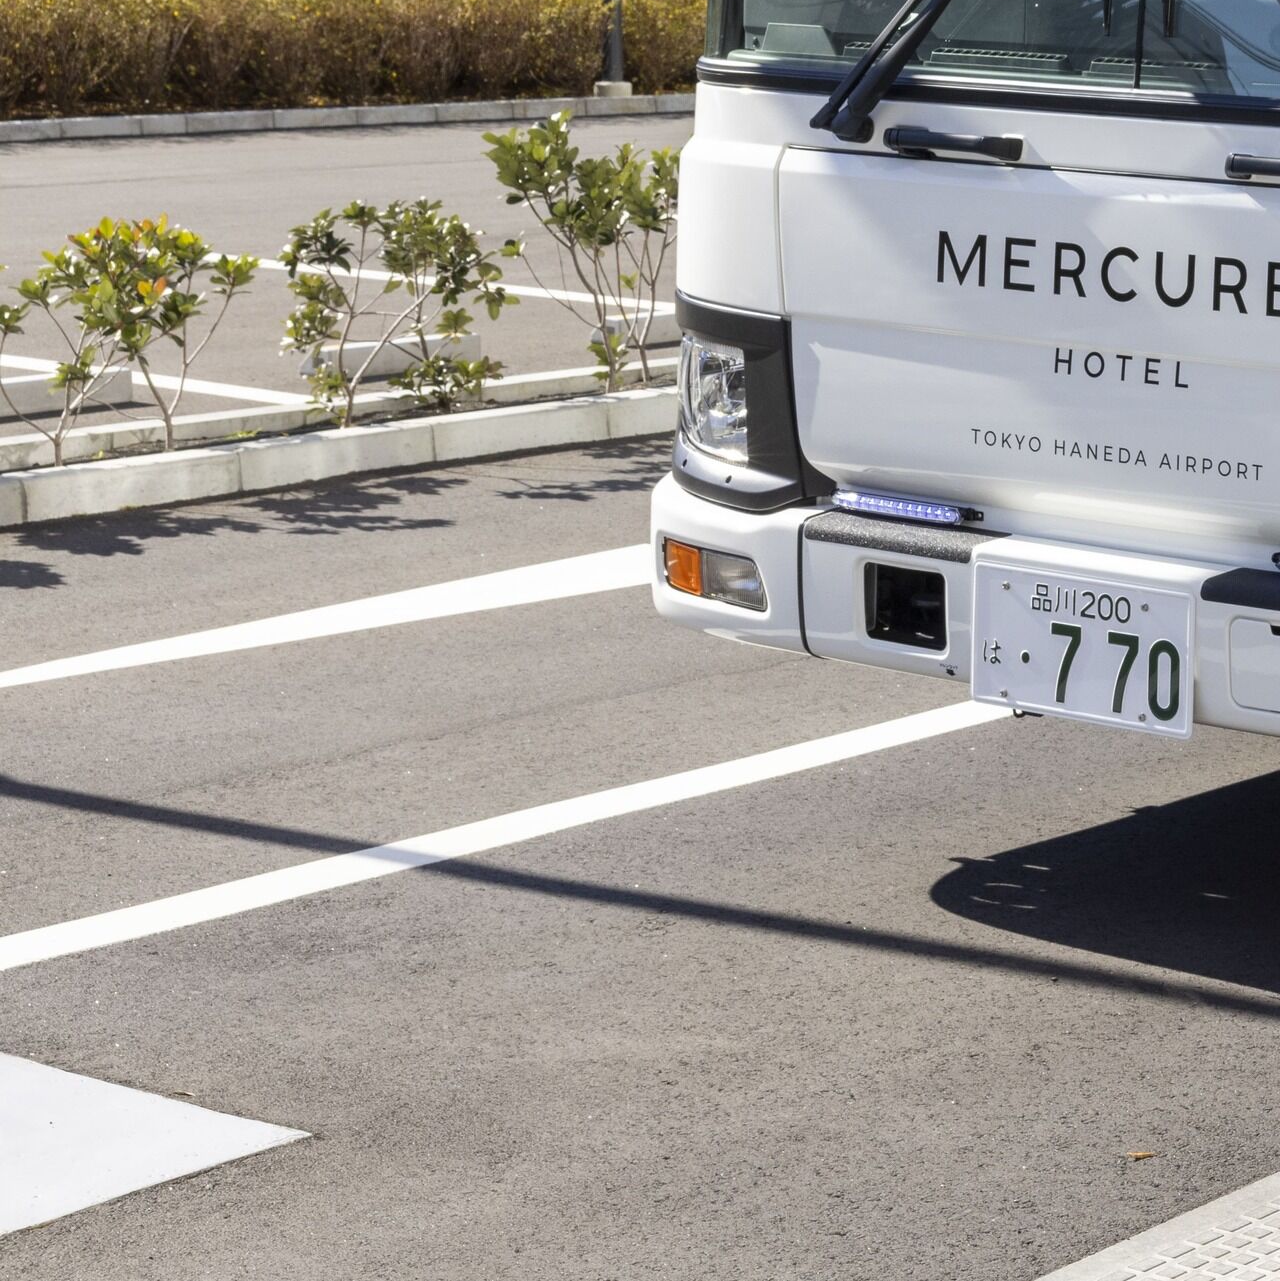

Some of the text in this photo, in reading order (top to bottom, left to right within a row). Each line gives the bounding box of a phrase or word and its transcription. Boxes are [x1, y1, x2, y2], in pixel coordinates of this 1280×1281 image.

[1053, 346, 1190, 389] HOTEL
[970, 427, 1265, 482] TOKYO HANEDA AIRPORT
[982, 638, 1002, 665] は
